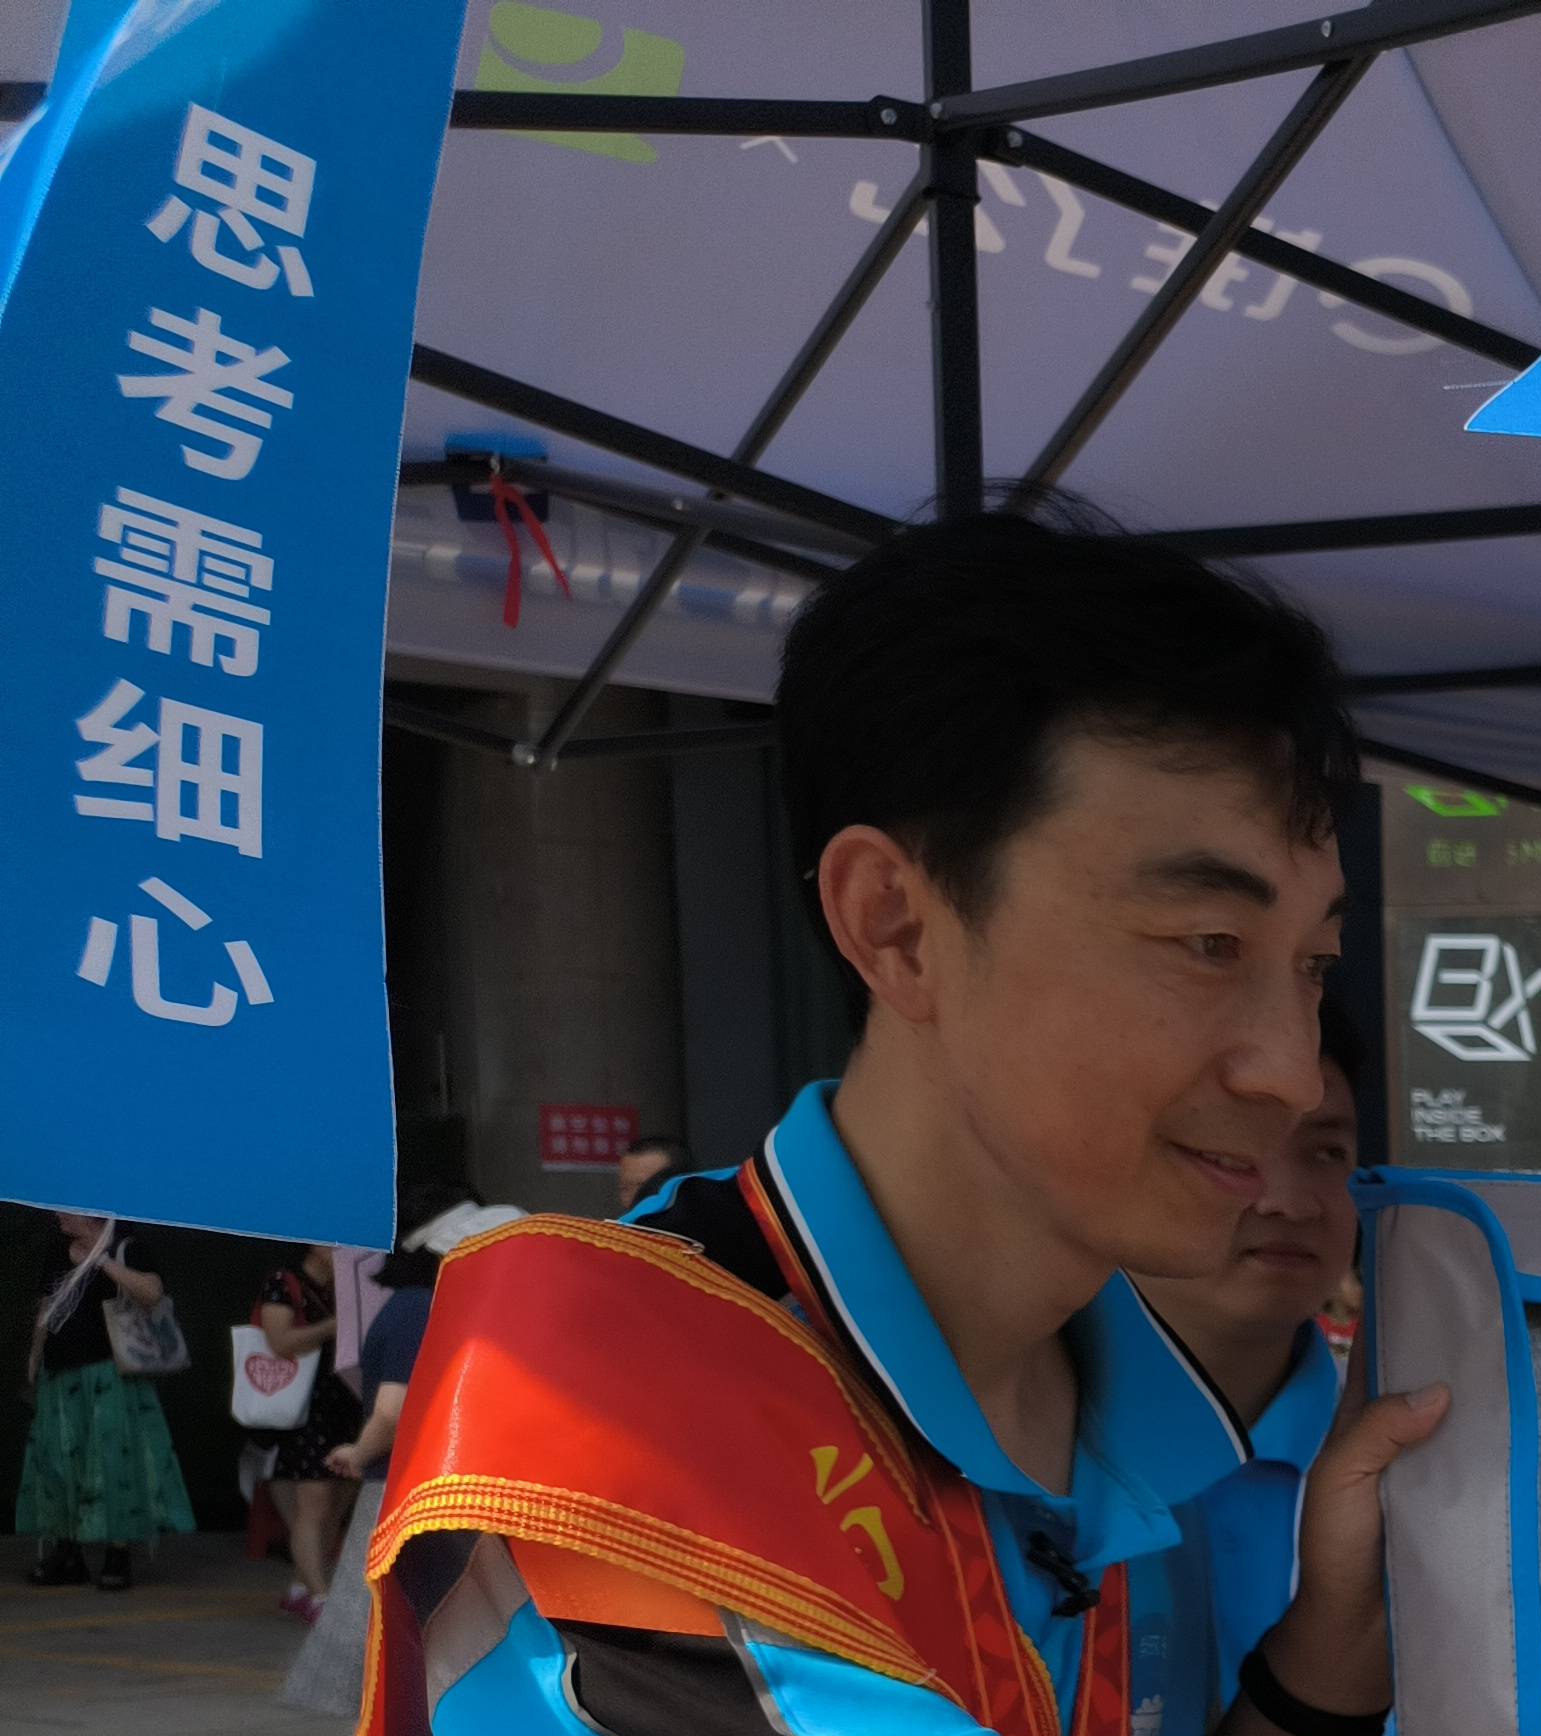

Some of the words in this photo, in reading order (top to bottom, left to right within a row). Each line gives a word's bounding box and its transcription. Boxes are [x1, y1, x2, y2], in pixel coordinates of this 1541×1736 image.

[74, 101, 319, 1028] 思考需细心
